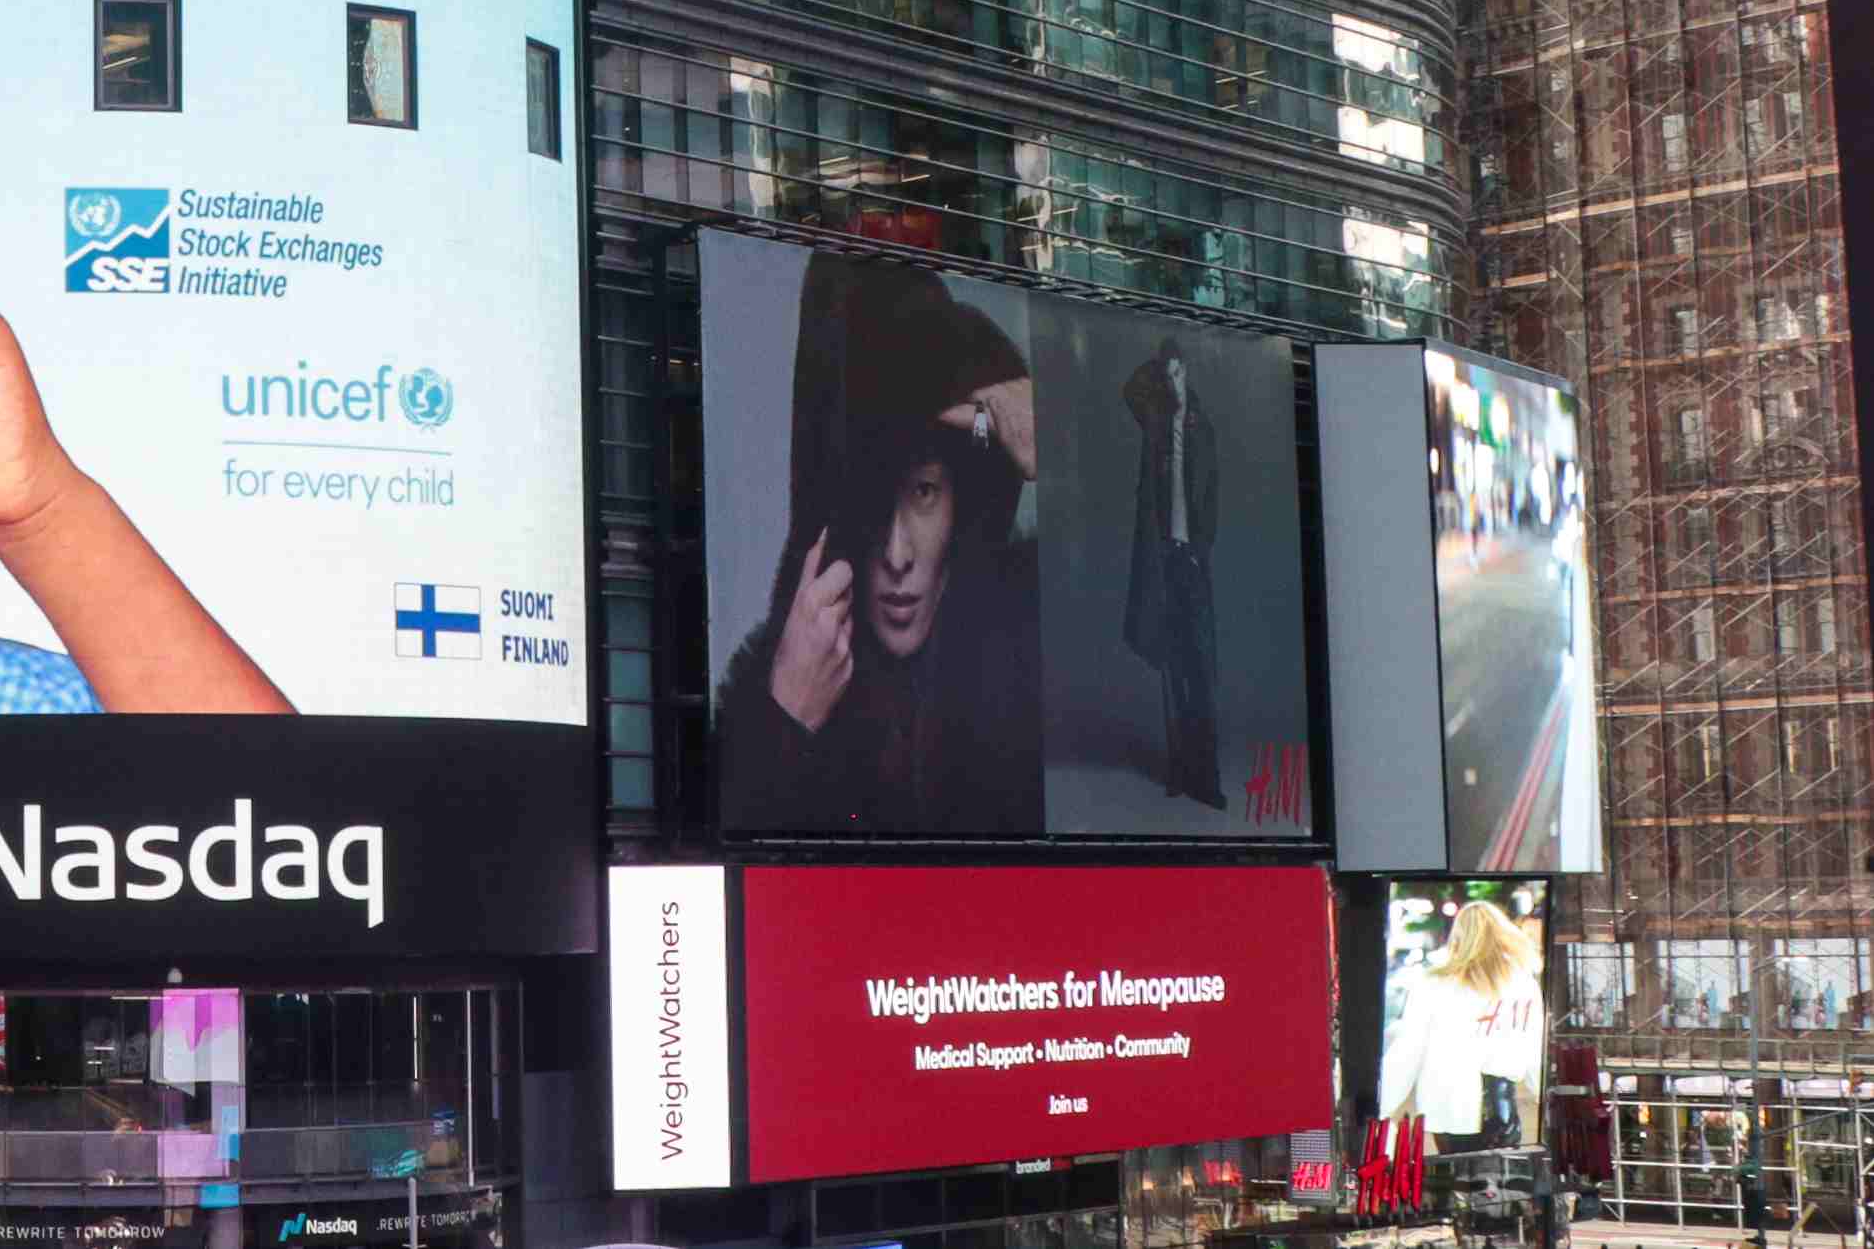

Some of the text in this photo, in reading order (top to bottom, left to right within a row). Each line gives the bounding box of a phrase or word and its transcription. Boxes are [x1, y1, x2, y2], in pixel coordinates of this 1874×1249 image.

[178, 189, 325, 224] Sustainable
[178, 228, 384, 271] Stock Exchanges
[87, 257, 169, 292] SSE
[177, 266, 288, 299] Initiative
[221, 360, 393, 422] unicef
[222, 458, 455, 509] for every child
[500, 590, 554, 621] SUOMI
[501, 635, 569, 667] FINLAND
[866, 969, 1226, 1024] WeightWatchers for Menopause
[657, 899, 689, 1161] WeightWatchers
[914, 1031, 1191, 1070] Medical Support Nutrition Community
[1048, 1095, 1089, 1114] Join us
[306, 1217, 357, 1235] Nasdaq
[380, 1217, 427, 1231] REWRTE
